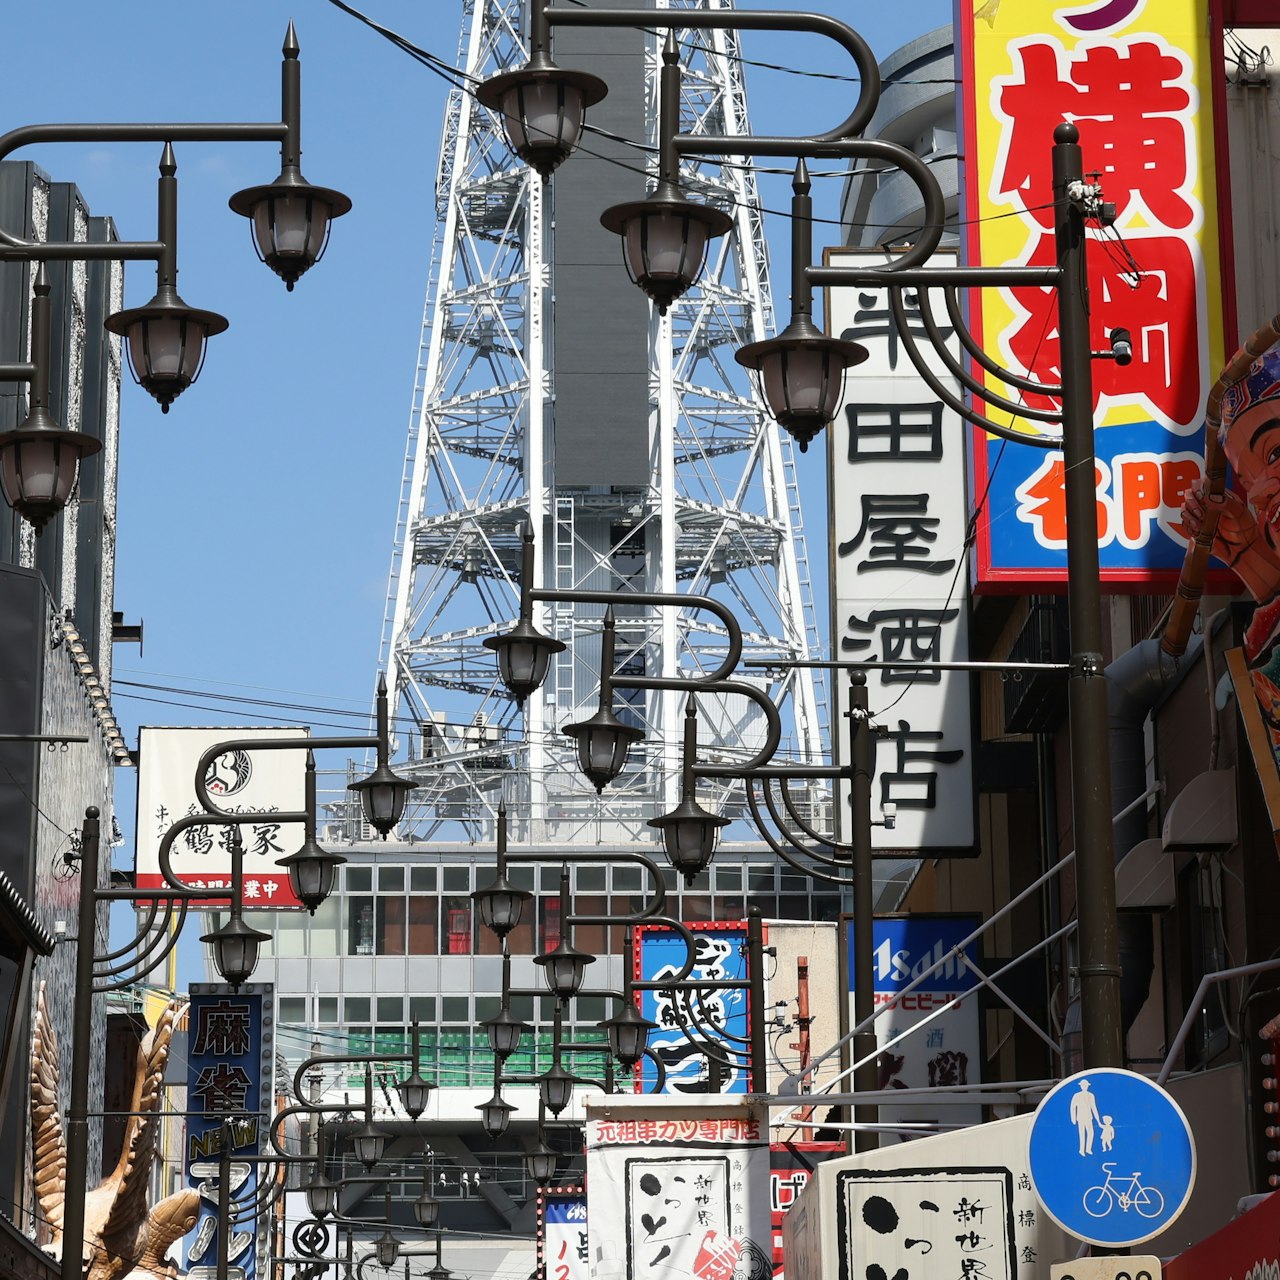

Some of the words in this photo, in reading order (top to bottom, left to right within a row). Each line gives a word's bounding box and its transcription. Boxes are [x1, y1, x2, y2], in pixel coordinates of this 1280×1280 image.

[998, 41, 1202, 427] 横綱
[1020, 455, 1204, 543] 名門
[596, 1118, 761, 1143] 元祖串カツ専門店
[693, 1173, 718, 1227] 新世界
